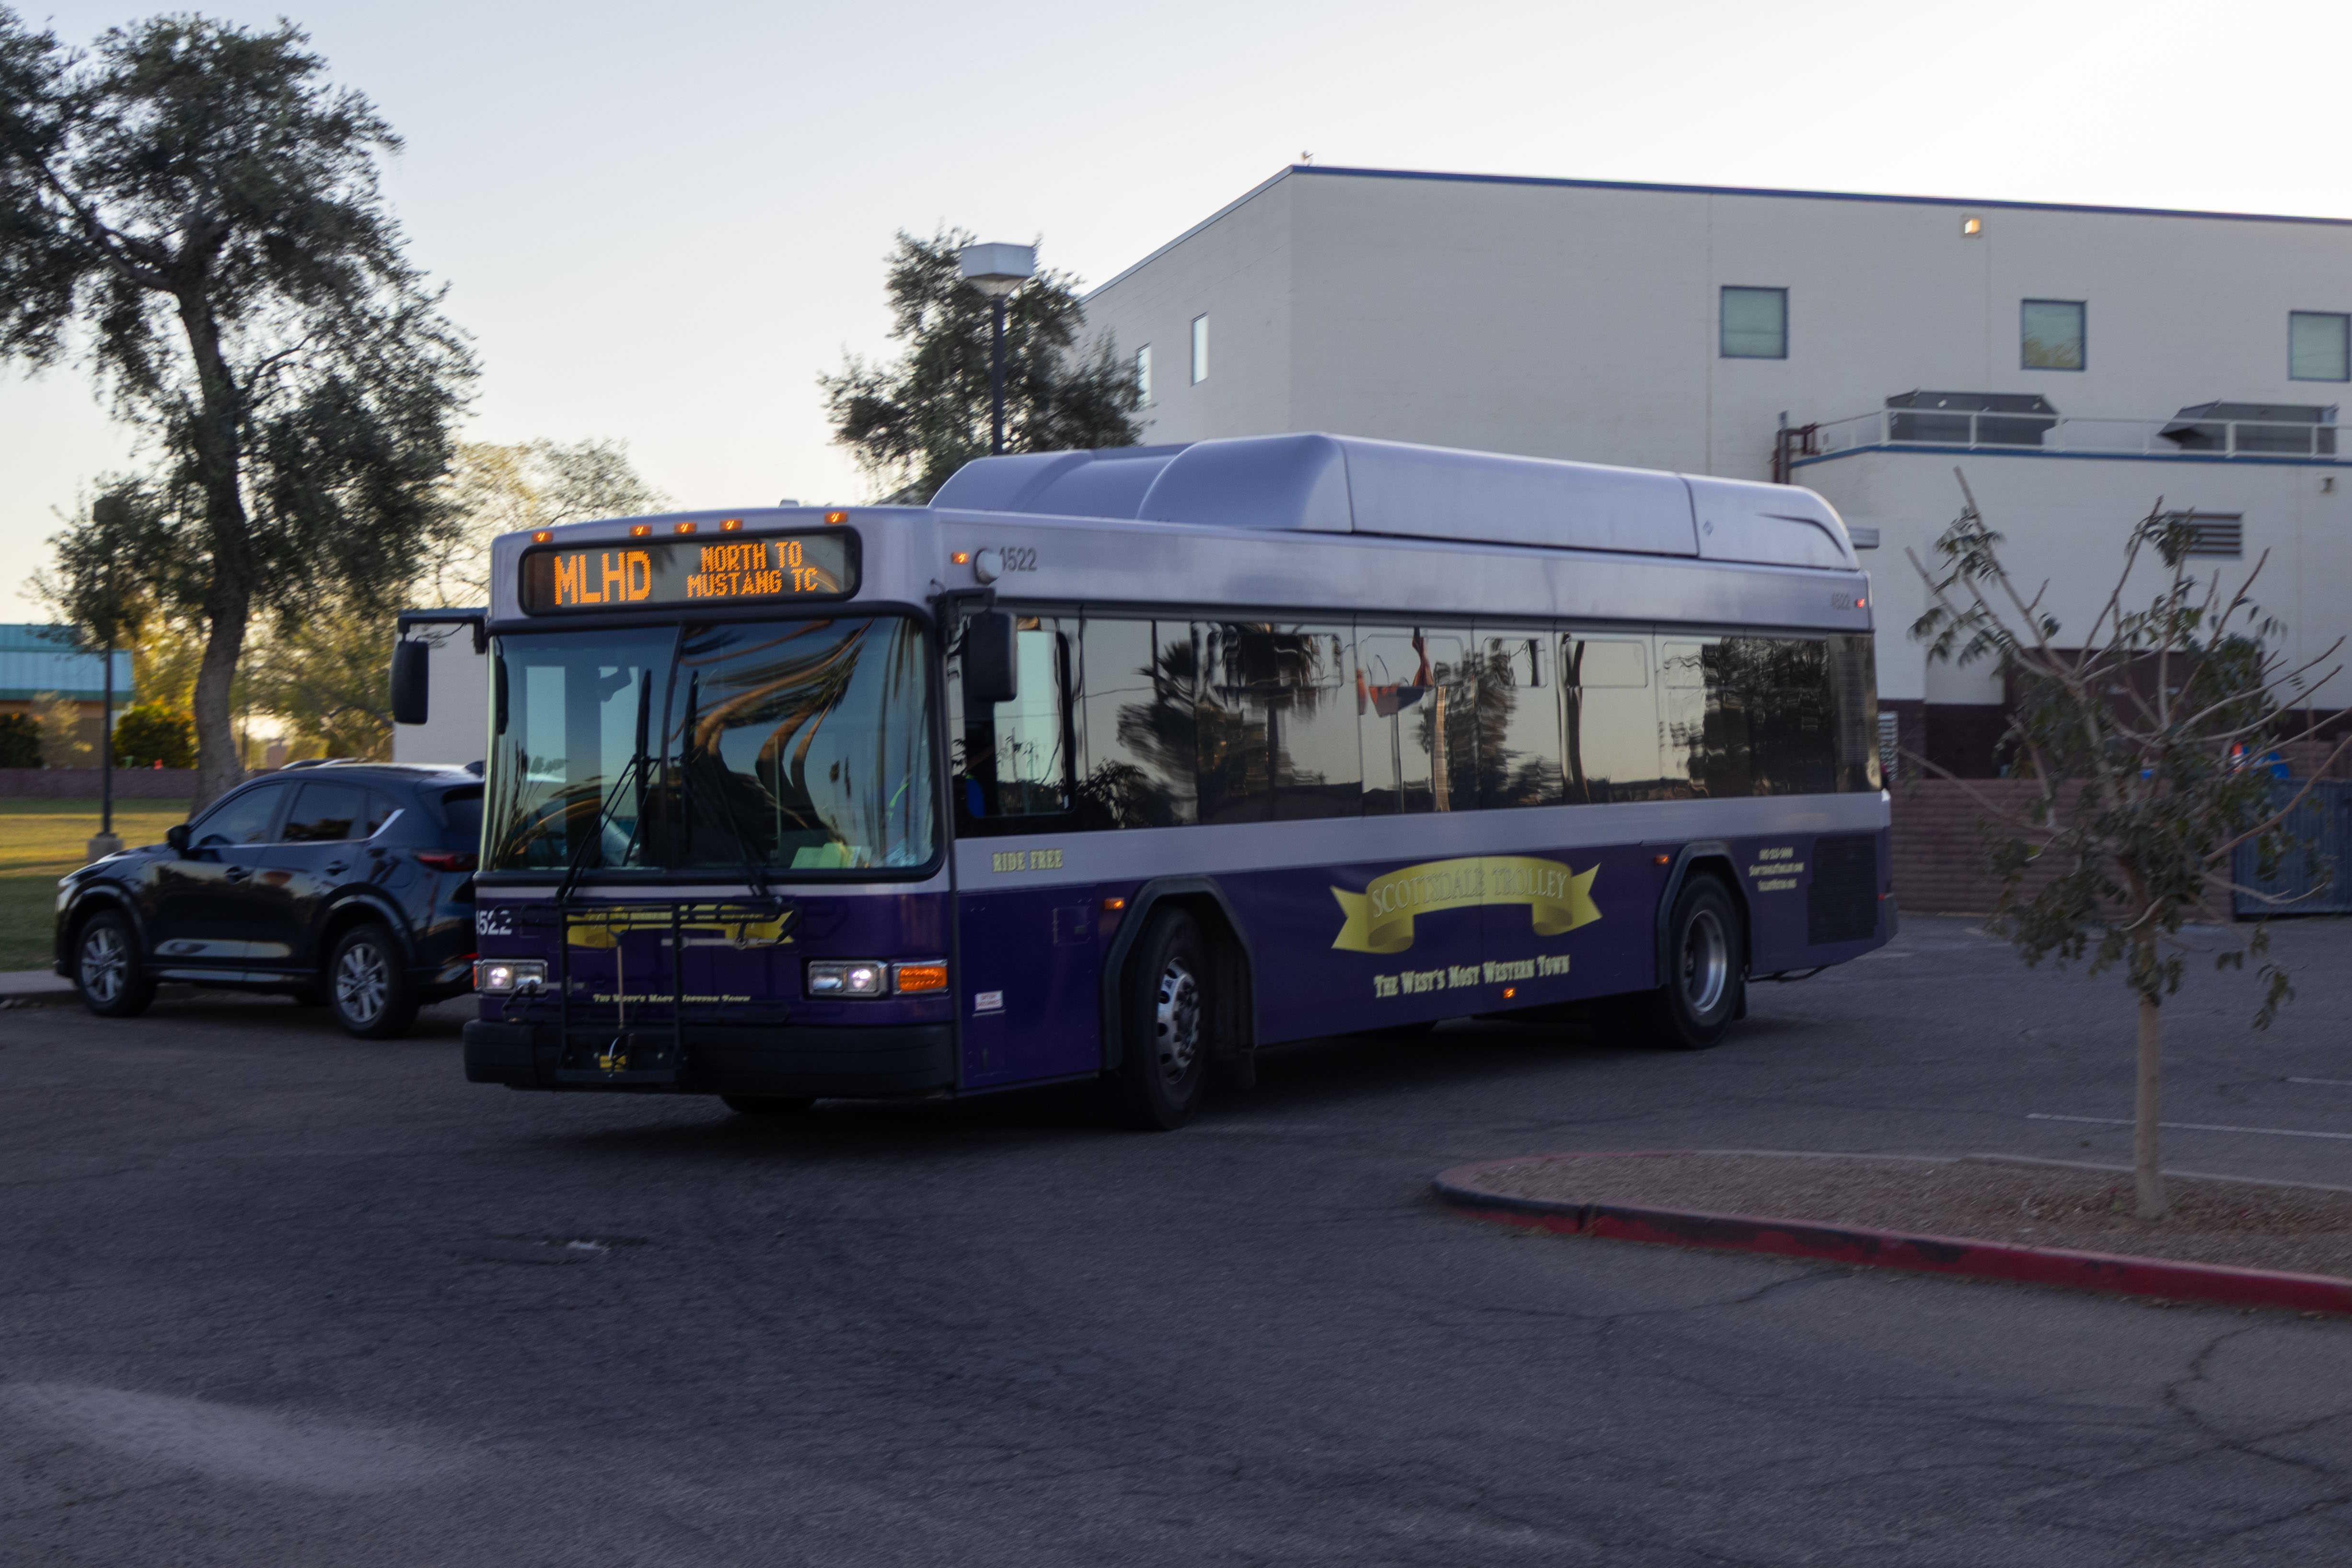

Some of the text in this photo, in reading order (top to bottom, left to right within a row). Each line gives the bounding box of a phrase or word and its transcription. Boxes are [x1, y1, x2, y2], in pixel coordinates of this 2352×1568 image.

[700, 541, 802, 572] NORTH TO
[1000, 546, 1037, 571] 1522
[554, 550, 652, 605] MLHD
[687, 567, 818, 598] MUSTANG TC
[992, 848, 1063, 873] RIDE FREE
[1371, 866, 1568, 918] SCOTTSDALE TROLLEY
